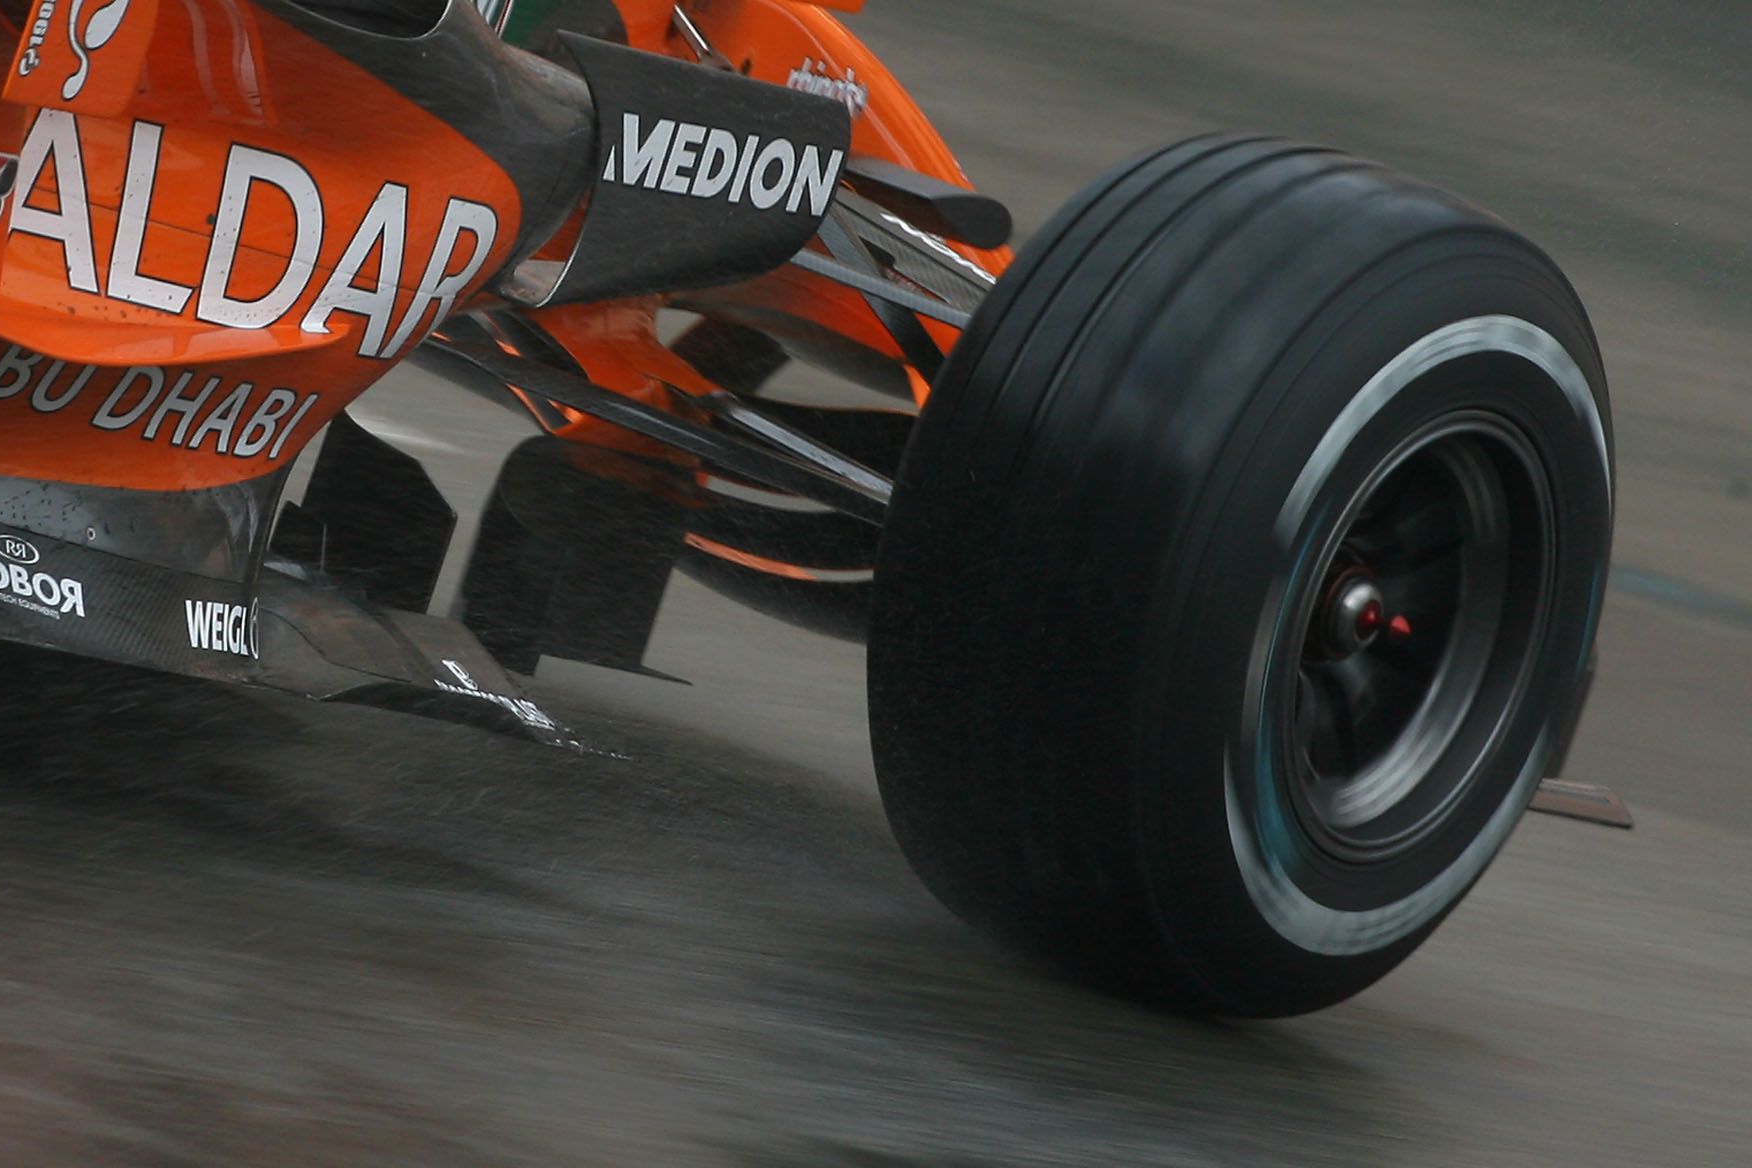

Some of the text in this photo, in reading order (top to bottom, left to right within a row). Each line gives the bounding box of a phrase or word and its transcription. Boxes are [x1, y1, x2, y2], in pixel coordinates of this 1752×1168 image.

[602, 112, 845, 217] MEDION
[8, 107, 499, 360] ALDAR
[90, 365, 320, 461] DHABI
